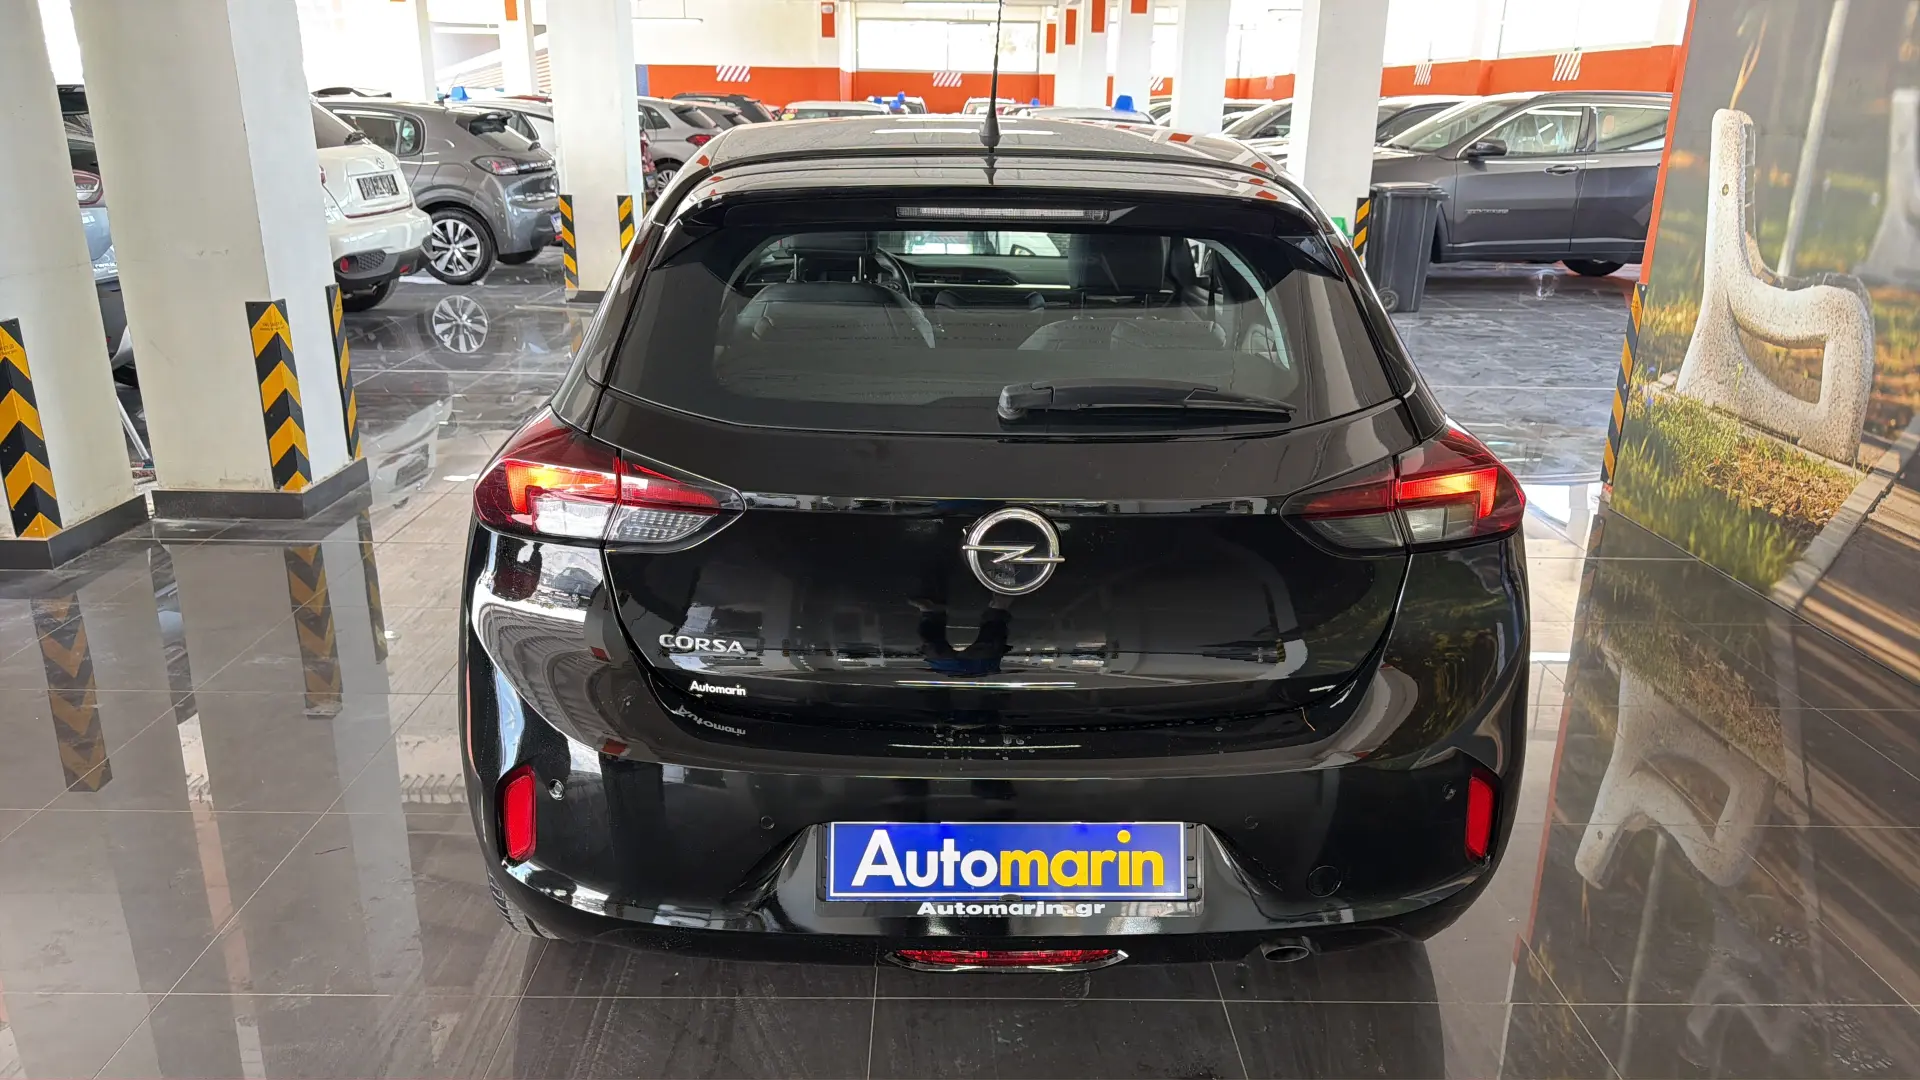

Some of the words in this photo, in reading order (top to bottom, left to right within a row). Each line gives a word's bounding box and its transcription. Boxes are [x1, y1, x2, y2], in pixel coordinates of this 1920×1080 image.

[659, 634, 747, 655] CORSA
[689, 680, 747, 696] Automarin
[851, 829, 1164, 888] Automarin
[916, 901, 1106, 918] Automarin.gr
